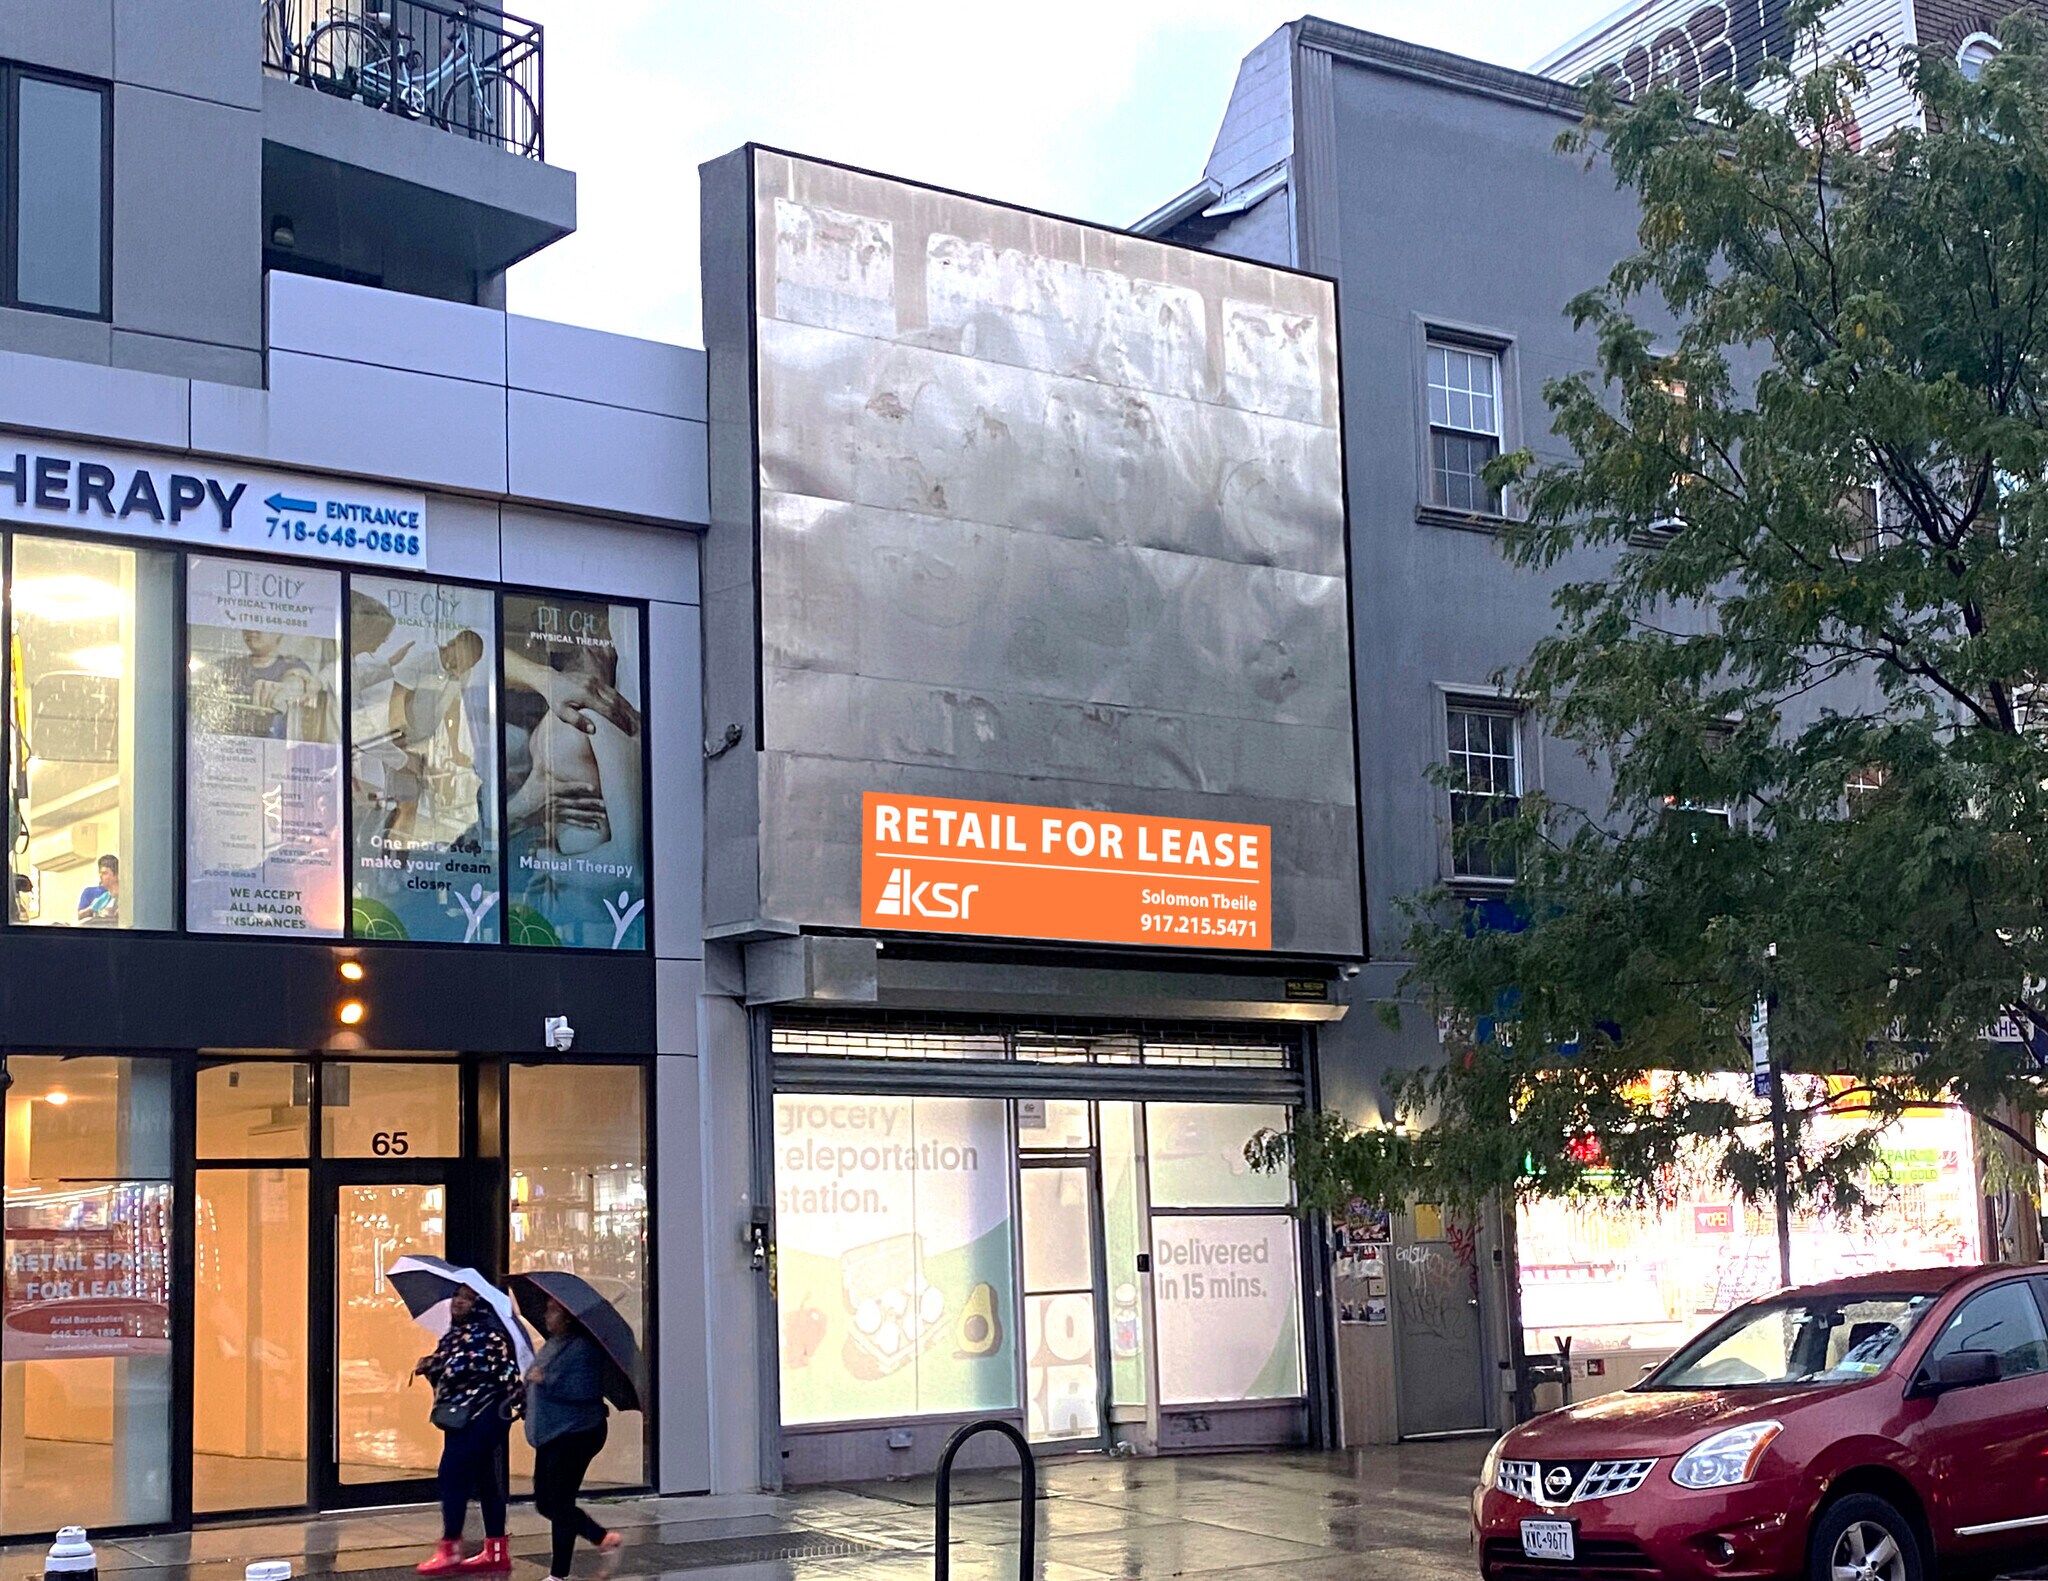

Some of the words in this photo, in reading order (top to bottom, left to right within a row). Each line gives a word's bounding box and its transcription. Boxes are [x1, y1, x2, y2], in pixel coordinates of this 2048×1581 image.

[326, 501, 420, 529] ENTRANCE
[266, 517, 420, 556] 718-648-0888
[227, 569, 253, 597] PT
[262, 573, 305, 600] City
[217, 596, 266, 609] PHYSICAL
[269, 601, 314, 615] THERAPY
[387, 589, 411, 616] PT
[537, 605, 561, 628] PT
[529, 630, 575, 645] PHYSICAL
[575, 635, 616, 649] THERAPY
[370, 834, 402, 851] One
[450, 838, 482, 858] step
[875, 804, 1027, 852] RETAIL
[1041, 818, 1124, 860] FOR
[1137, 826, 1260, 870] LEASE
[360, 854, 402, 870] make
[406, 859, 441, 874] your
[445, 858, 491, 875] dream
[519, 855, 572, 873] Manual
[576, 858, 633, 878] Therapy
[229, 886, 251, 899] WE
[253, 889, 302, 901] ACCEPT
[406, 876, 452, 892] closer
[229, 901, 254, 913] ALL
[257, 903, 303, 916] MAJOR
[1141, 888, 1210, 909] Solomon
[1210, 892, 1258, 912] Tbeile
[225, 915, 307, 930] INSURANCES
[1140, 913, 1258, 939] 917.215.5471
[778, 1104, 899, 1137] grocery
[371, 1131, 409, 1156] 65
[1876, 1148, 1920, 1162] EPAIR
[780, 1137, 979, 1179] eleportation
[1910, 1168, 1939, 1181] GOLD
[10, 1252, 88, 1272] RETAIL
[1157, 1237, 1269, 1266] Delivered
[26, 1280, 74, 1300] FOR
[1158, 1272, 1178, 1300] in
[1182, 1273, 1205, 1300] 15
[1209, 1271, 1268, 1299] mins.
